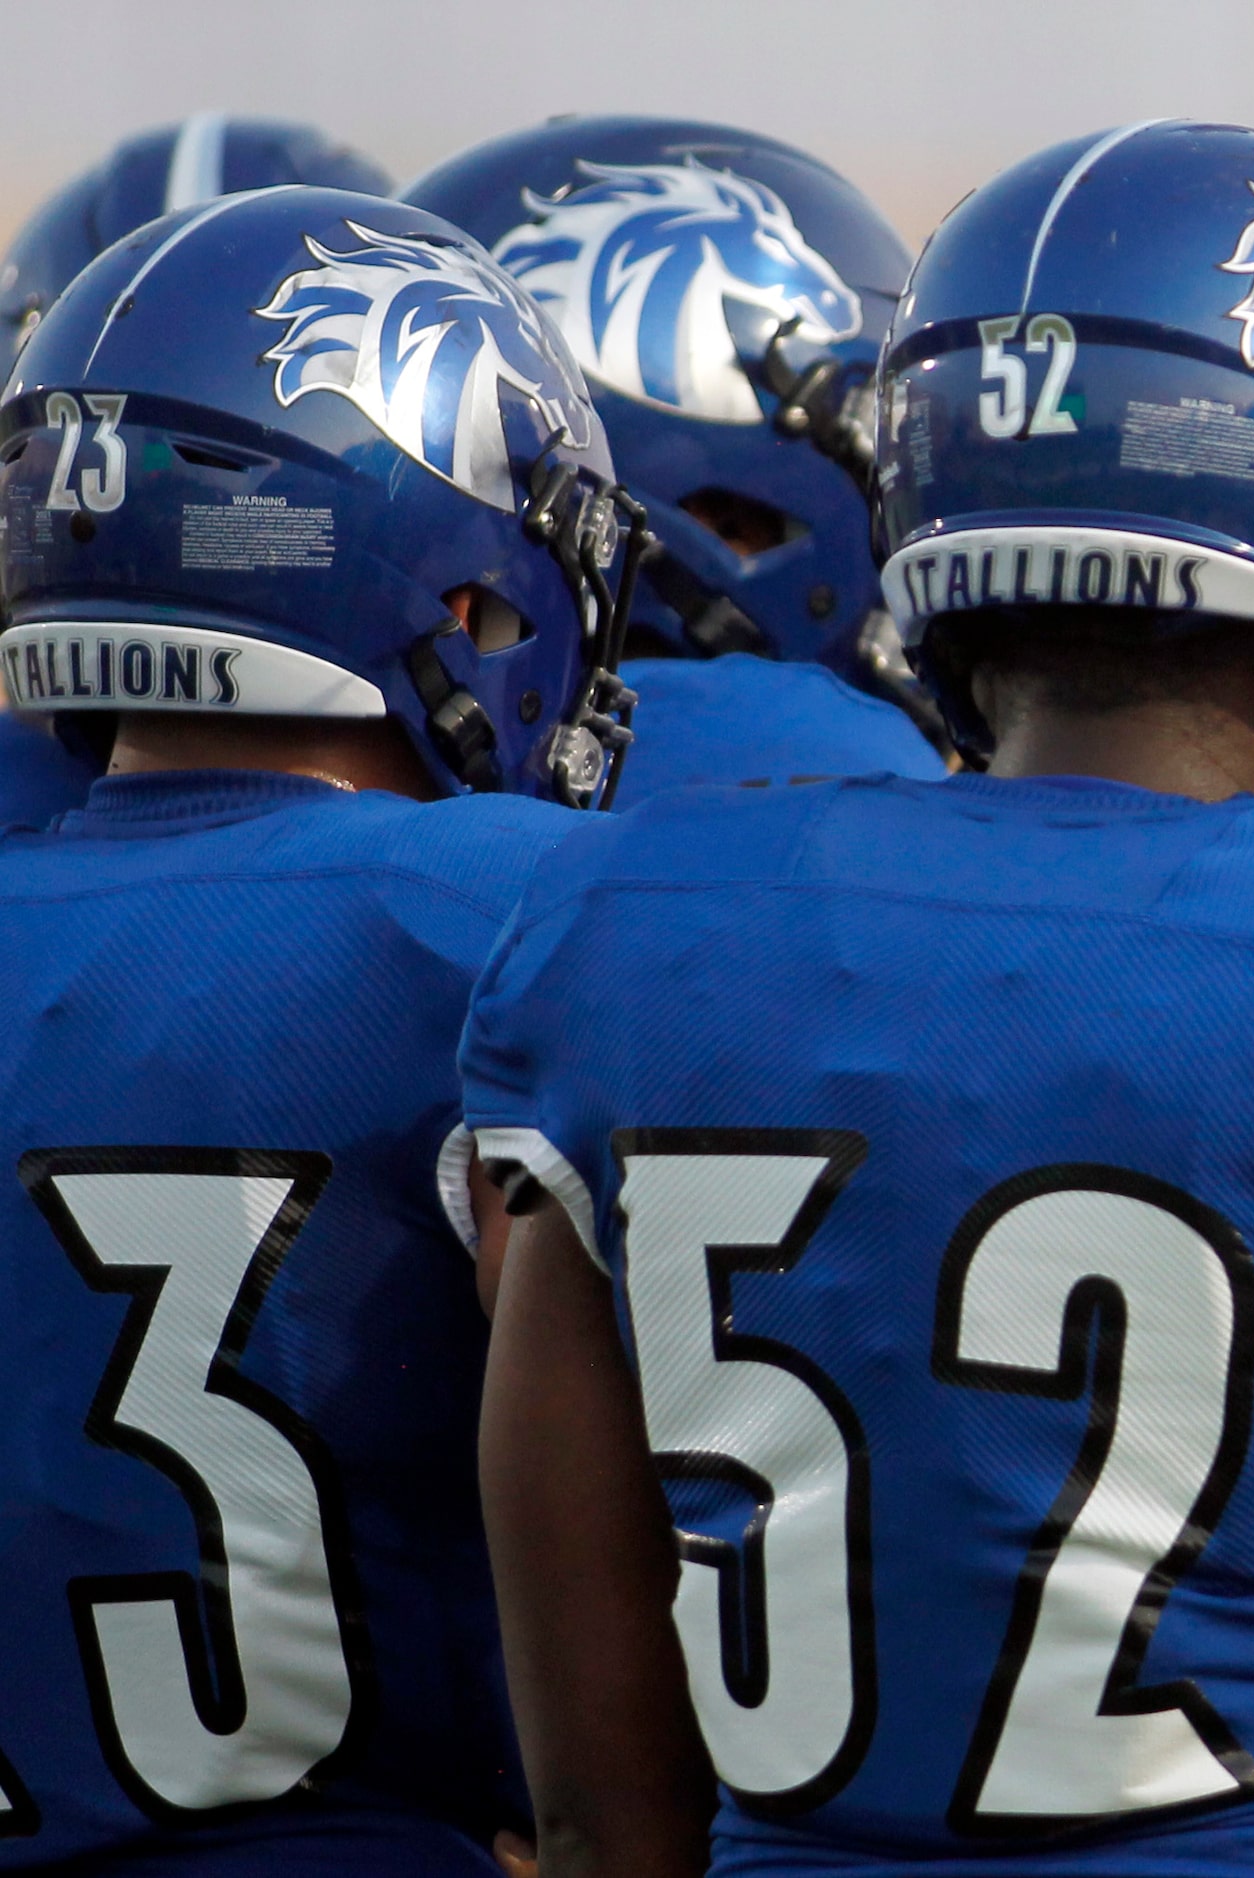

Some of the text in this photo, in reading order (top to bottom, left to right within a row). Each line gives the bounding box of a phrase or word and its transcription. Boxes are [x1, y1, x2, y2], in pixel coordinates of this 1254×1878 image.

[977, 313, 1079, 437] 52
[46, 391, 128, 512] 23
[232, 496, 287, 507] WARNING
[3, 638, 242, 706] TALLIONS
[0, 1145, 375, 1836] 3
